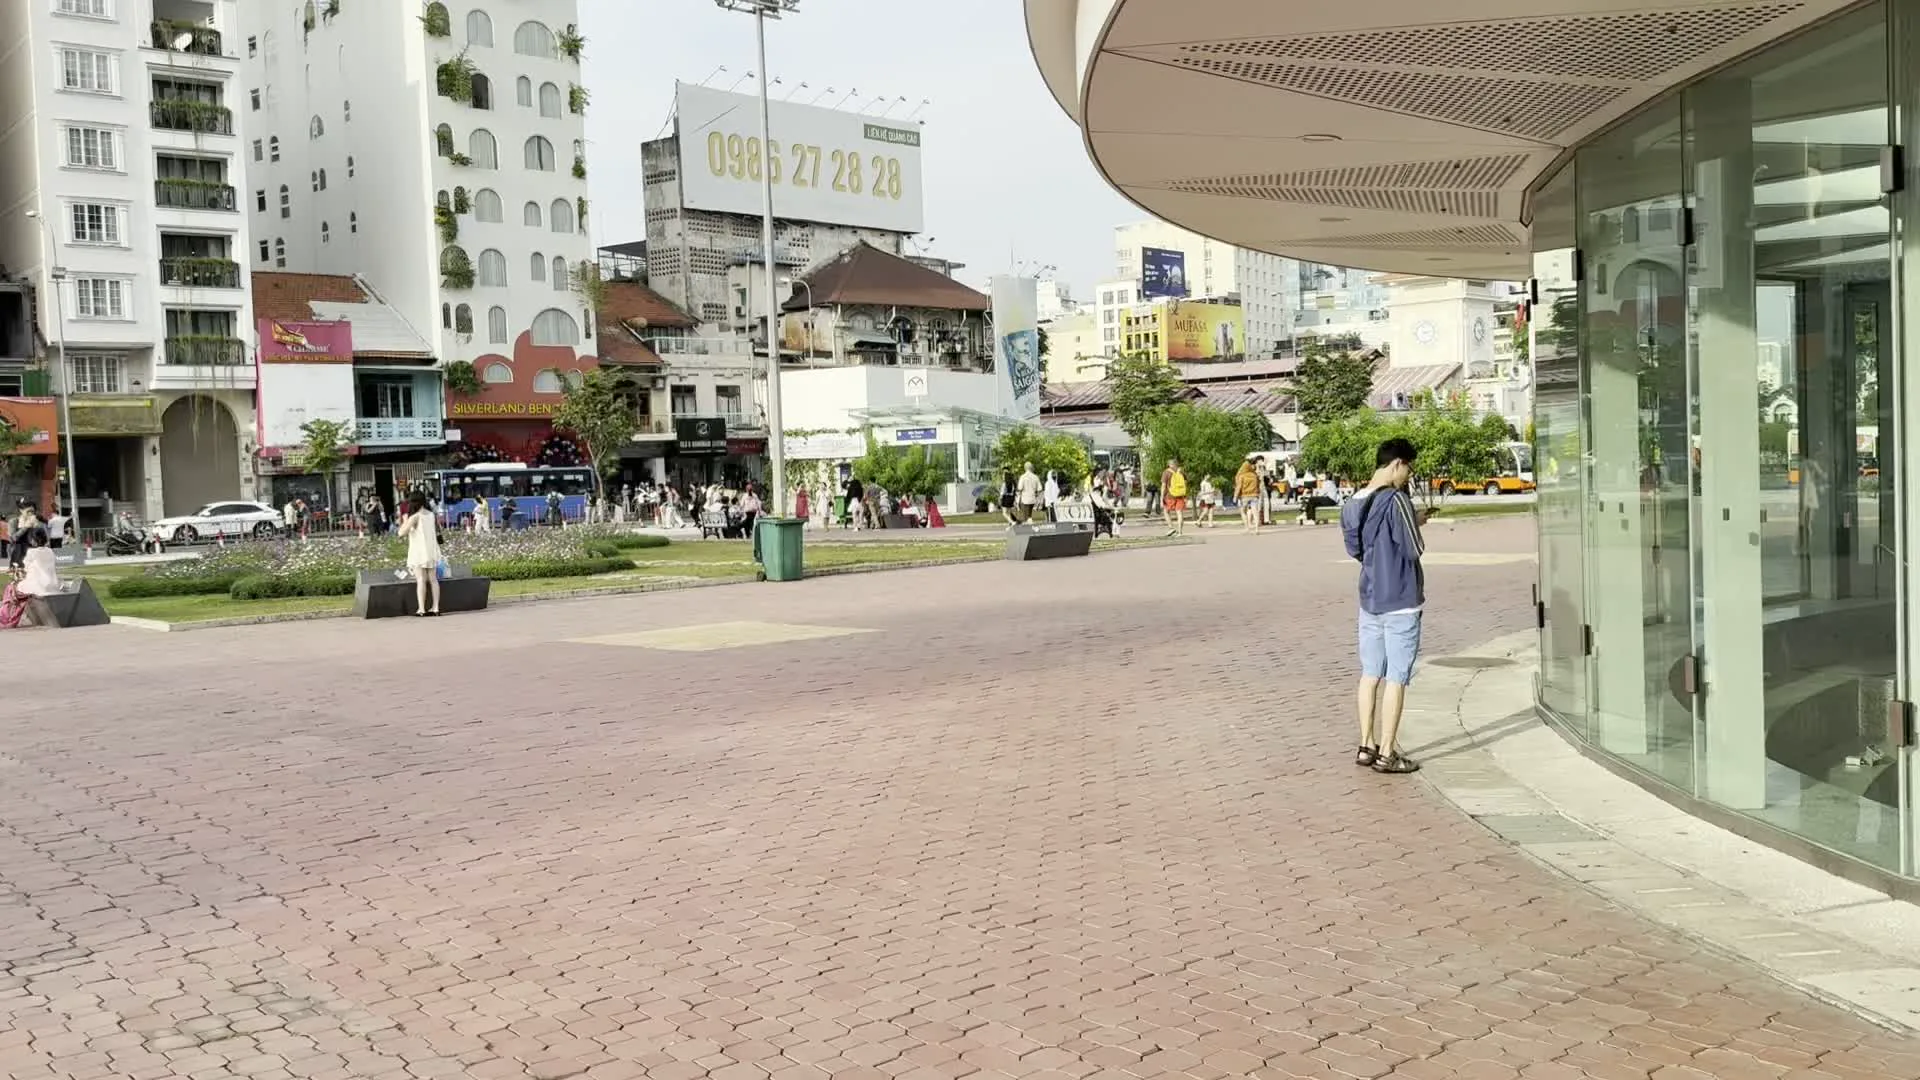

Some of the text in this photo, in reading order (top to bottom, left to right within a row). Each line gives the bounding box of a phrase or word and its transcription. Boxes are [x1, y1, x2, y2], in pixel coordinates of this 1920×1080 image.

[707, 131, 902, 201] 0986 27 28 28
[1174, 319, 1209, 333] MUFASA
[453, 403, 526, 414] SILVERLAND
[528, 403, 552, 414] BEN
